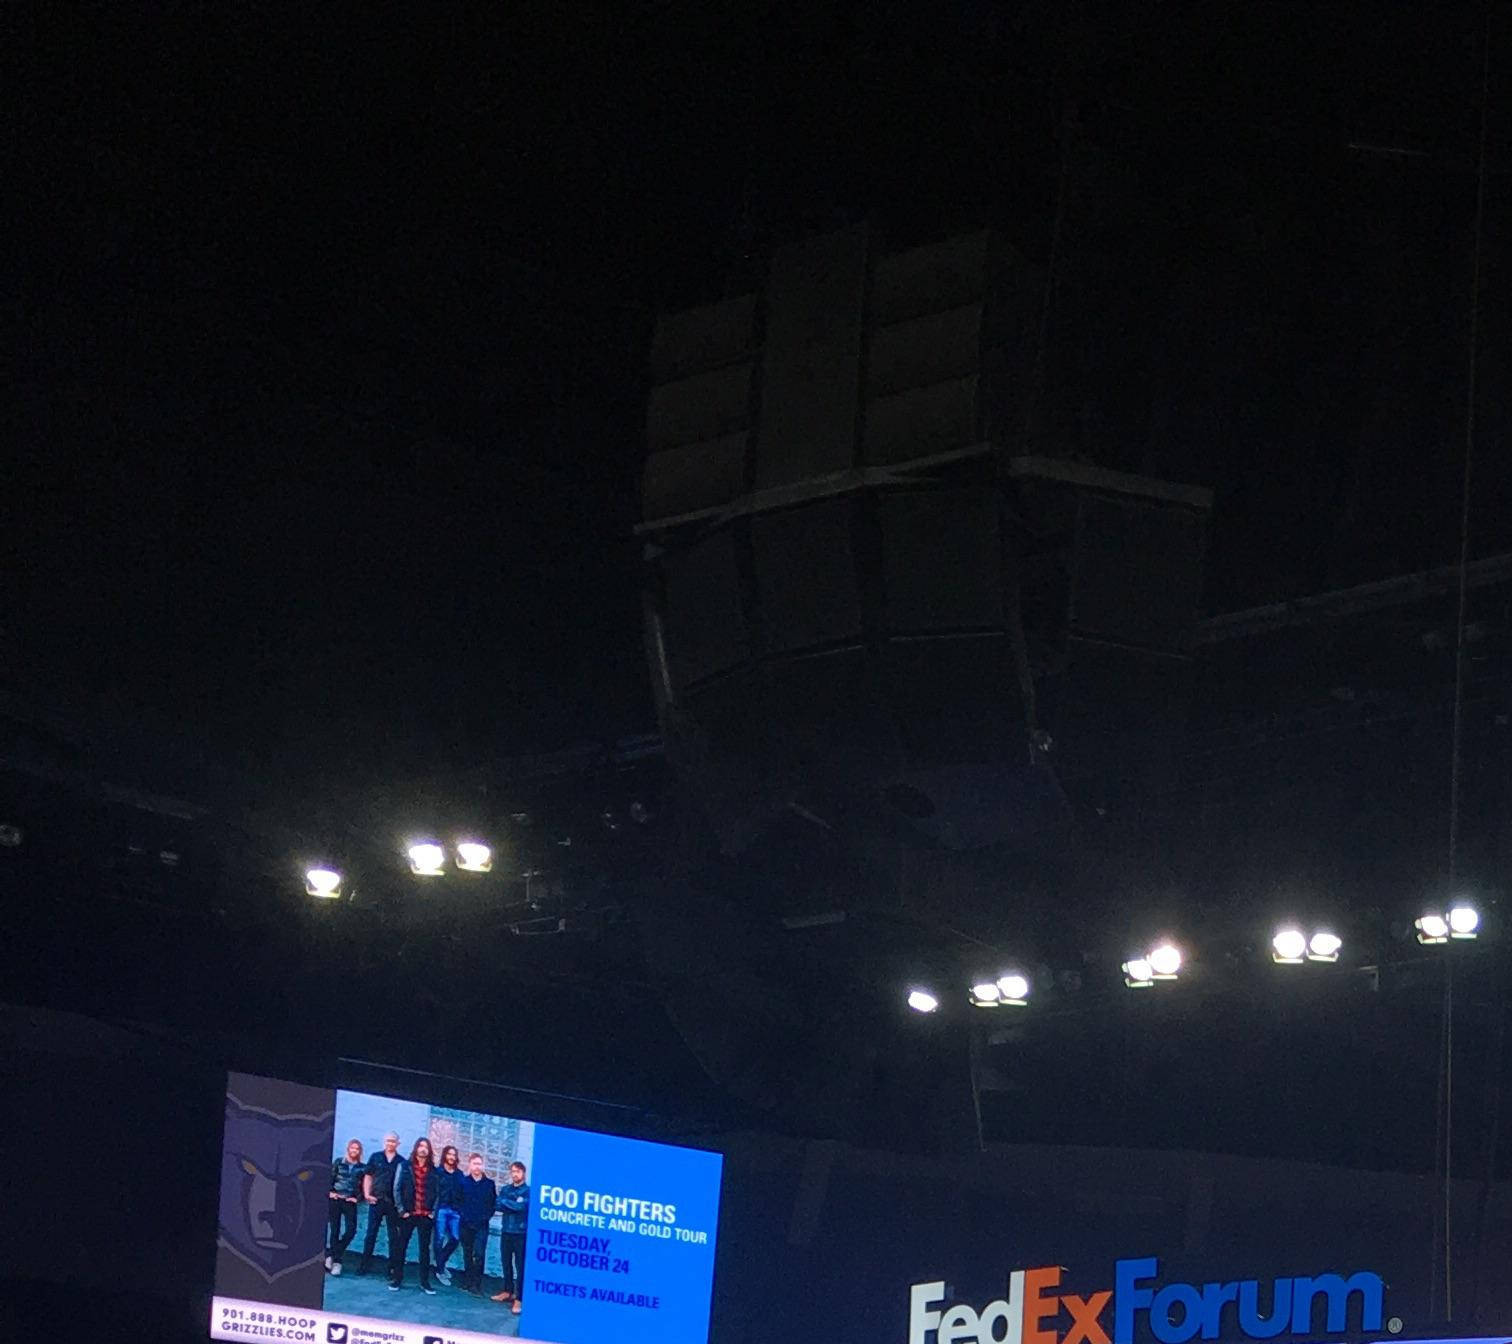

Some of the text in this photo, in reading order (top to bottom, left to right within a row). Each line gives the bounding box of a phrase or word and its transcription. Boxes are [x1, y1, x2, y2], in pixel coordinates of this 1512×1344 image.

[539, 1185, 676, 1224] FOO FIGHTERS
[540, 1207, 708, 1244] CONCRETE AND GOLD TOUR
[537, 1229, 611, 1256] TUESDAY,
[536, 1247, 630, 1274] OCTOBER 24
[534, 1280, 660, 1309] TICKETS AVAILABLE
[221, 1321, 315, 1342] GRIZZLIES.COM
[222, 1308, 316, 1329] 901.888.HOOP
